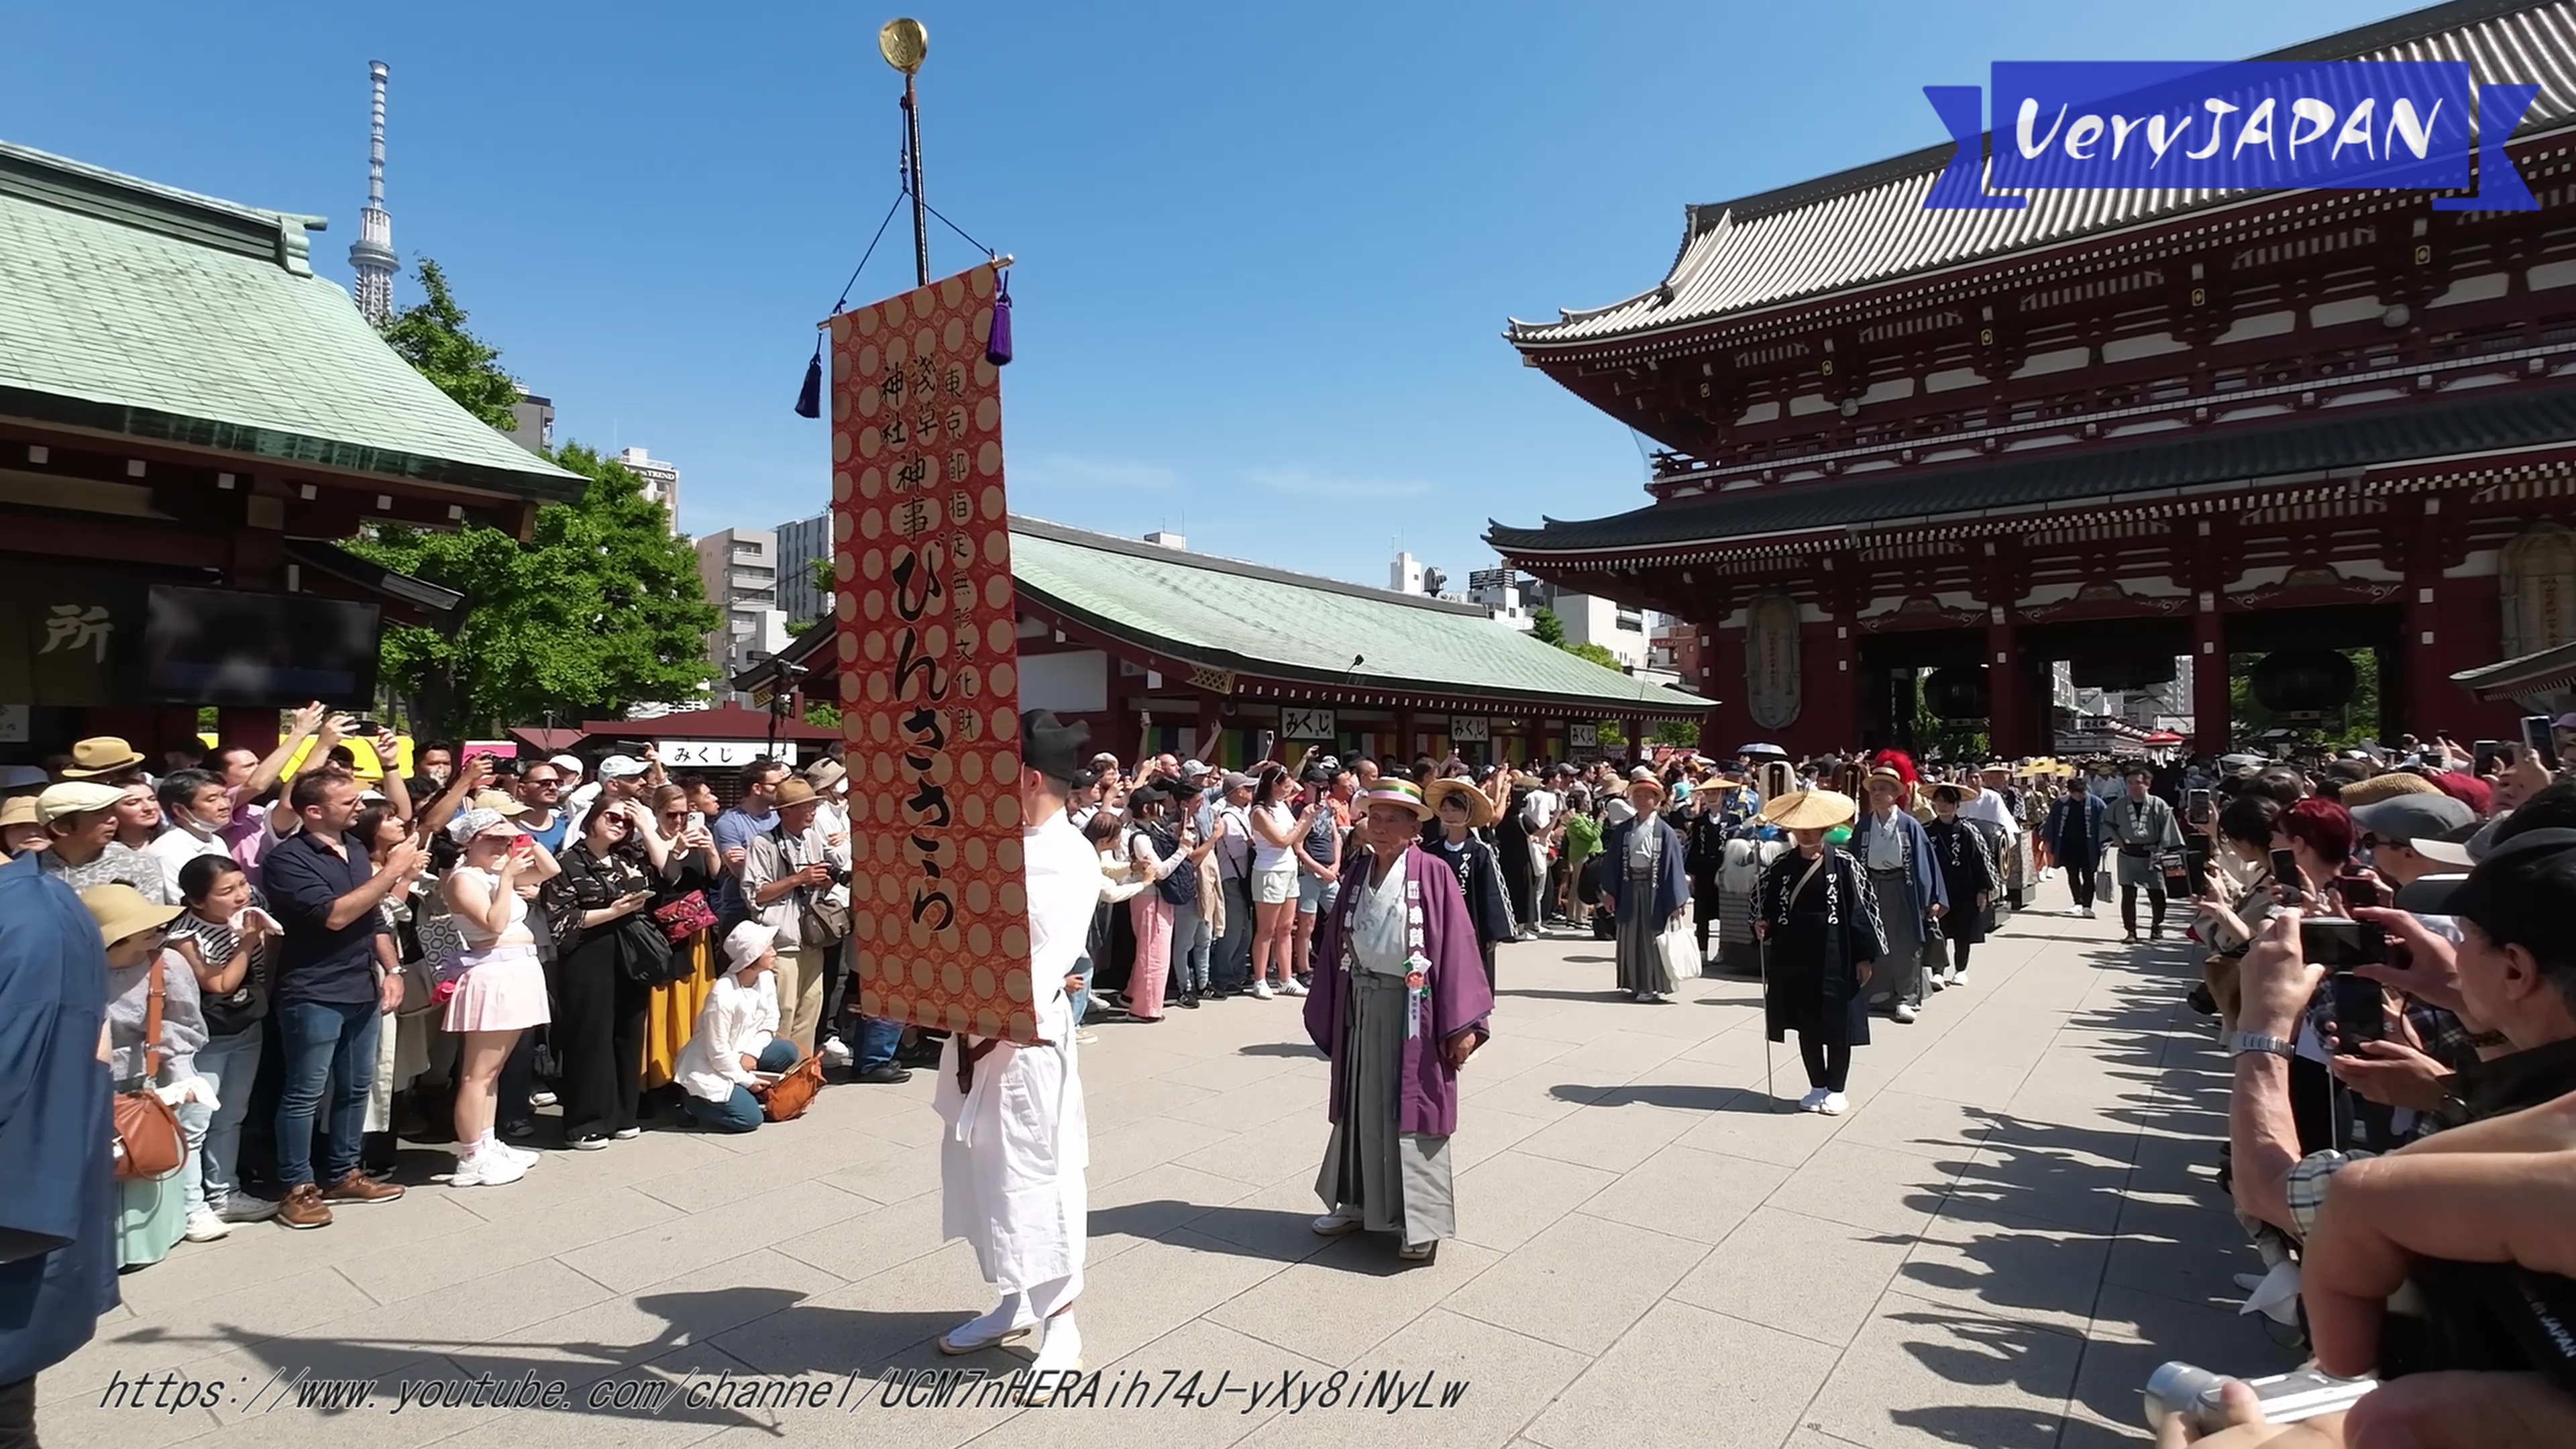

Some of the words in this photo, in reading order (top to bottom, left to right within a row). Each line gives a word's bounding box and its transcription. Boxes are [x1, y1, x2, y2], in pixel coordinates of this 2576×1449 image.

[943, 368, 974, 739] 東京都指定無形文化財
[38, 604, 115, 663] 所
[1286, 712, 1330, 733] みくじ
[1454, 719, 1485, 736] みくじ
[674, 746, 733, 763] みくじ
